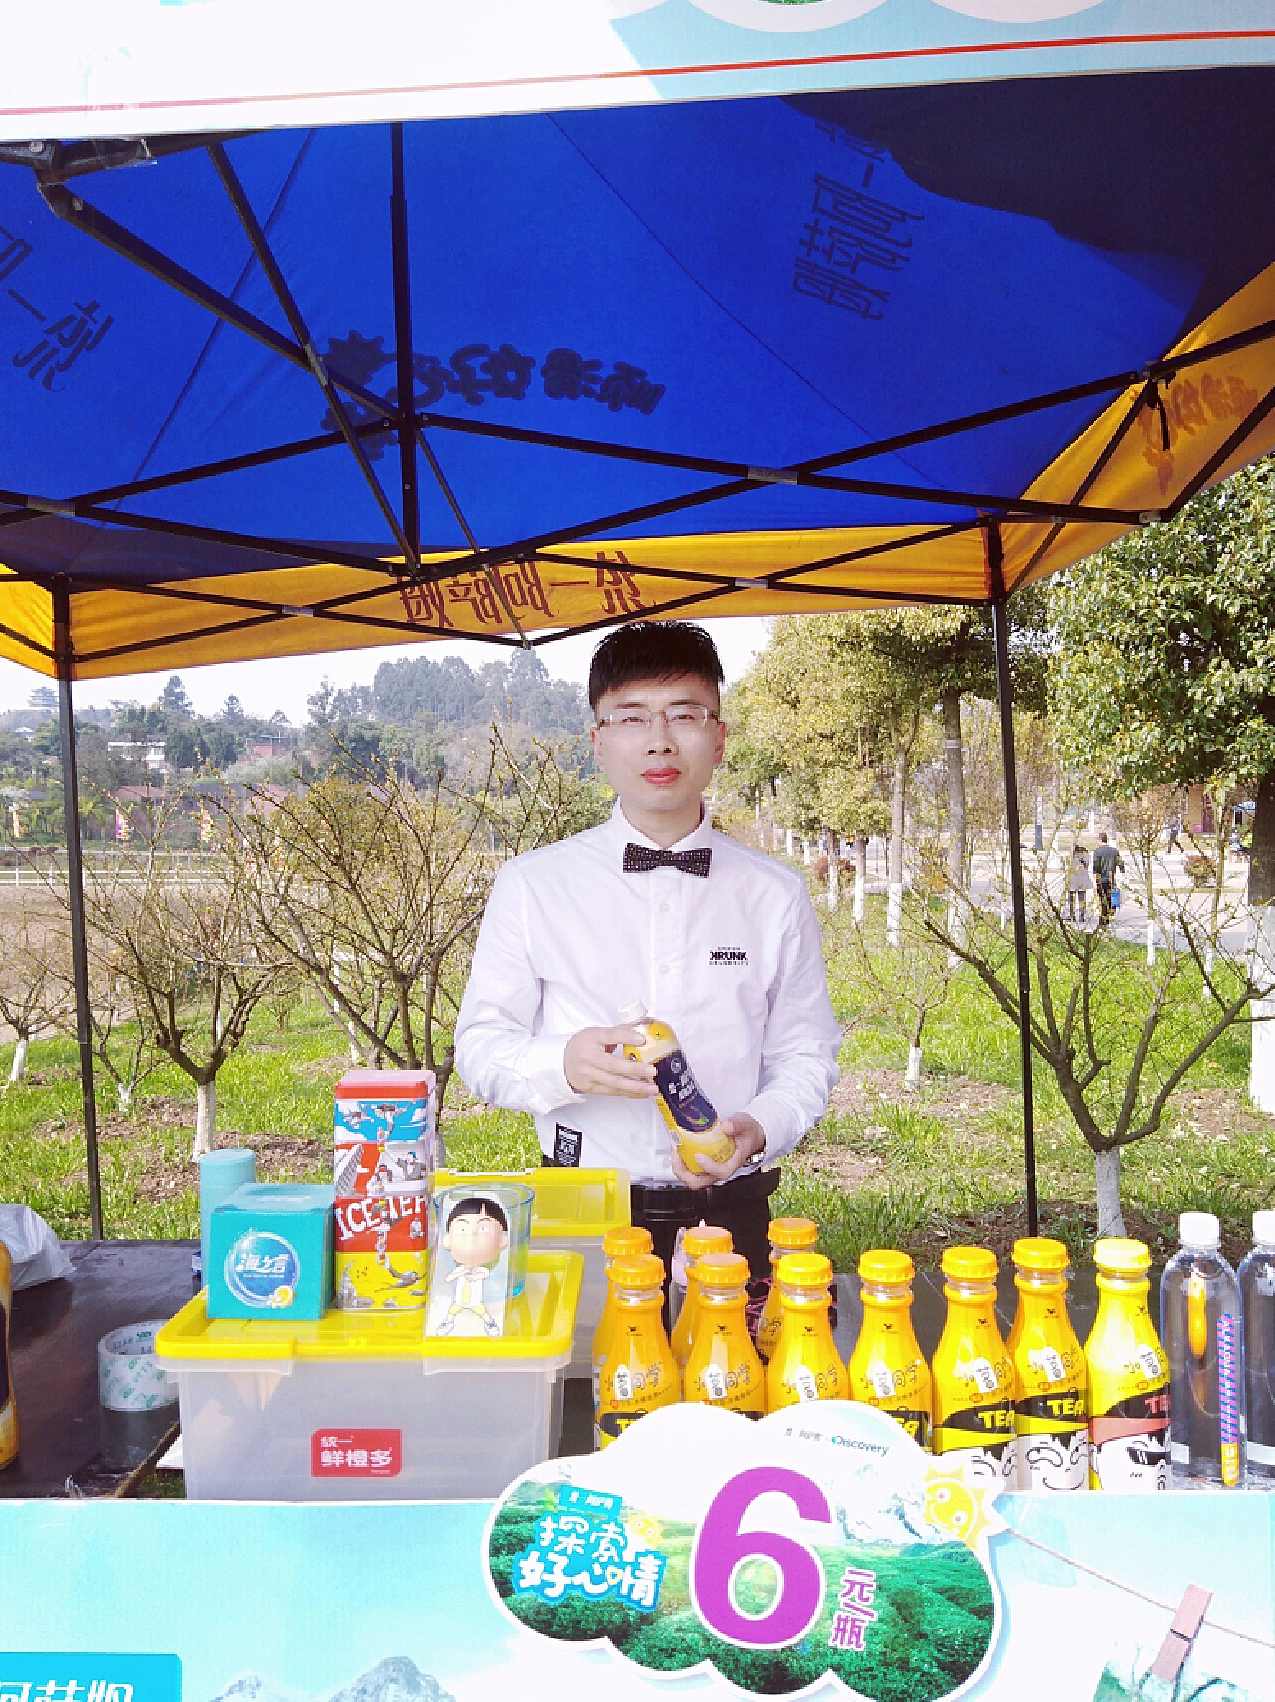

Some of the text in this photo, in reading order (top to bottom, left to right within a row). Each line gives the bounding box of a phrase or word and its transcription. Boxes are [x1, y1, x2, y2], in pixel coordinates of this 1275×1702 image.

[320, 1450, 392, 1468] 鲜橙多
[539, 1515, 627, 1563] 探索
[694, 1466, 833, 1645] 6
[519, 1550, 662, 1607] 好心情
